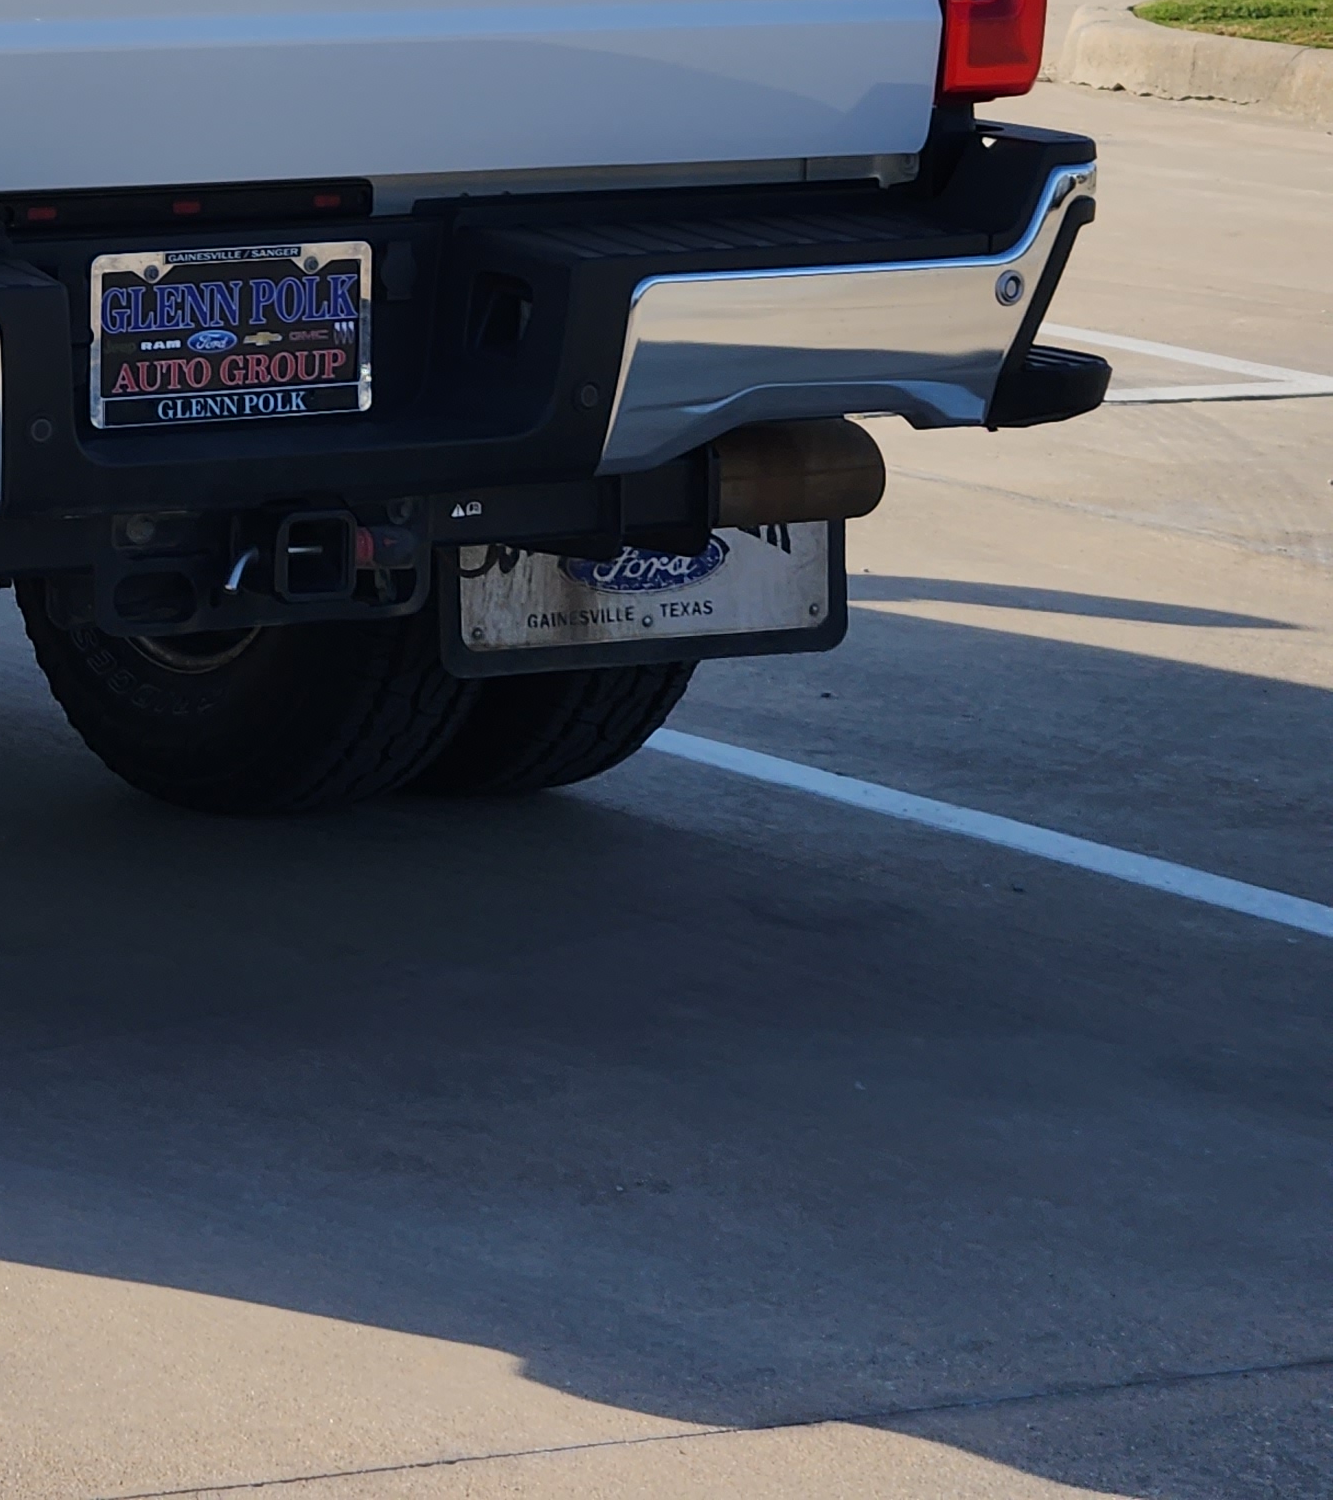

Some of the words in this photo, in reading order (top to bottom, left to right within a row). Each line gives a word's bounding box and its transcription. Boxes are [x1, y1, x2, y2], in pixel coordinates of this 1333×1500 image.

[167, 250, 241, 263] GAINESVILLE
[250, 247, 300, 258] SANGER
[101, 280, 243, 334] GLENN
[249, 274, 359, 326] POLK
[141, 339, 181, 351] RAM
[194, 334, 228, 350] Ford
[288, 329, 329, 342] GMC
[112, 357, 211, 393] AUTO
[219, 349, 346, 387] GROUP
[157, 396, 239, 420] GLENN
[243, 391, 308, 415] POLK
[527, 607, 635, 629] GAINESVILLE
[659, 601, 715, 619] TEXAS
